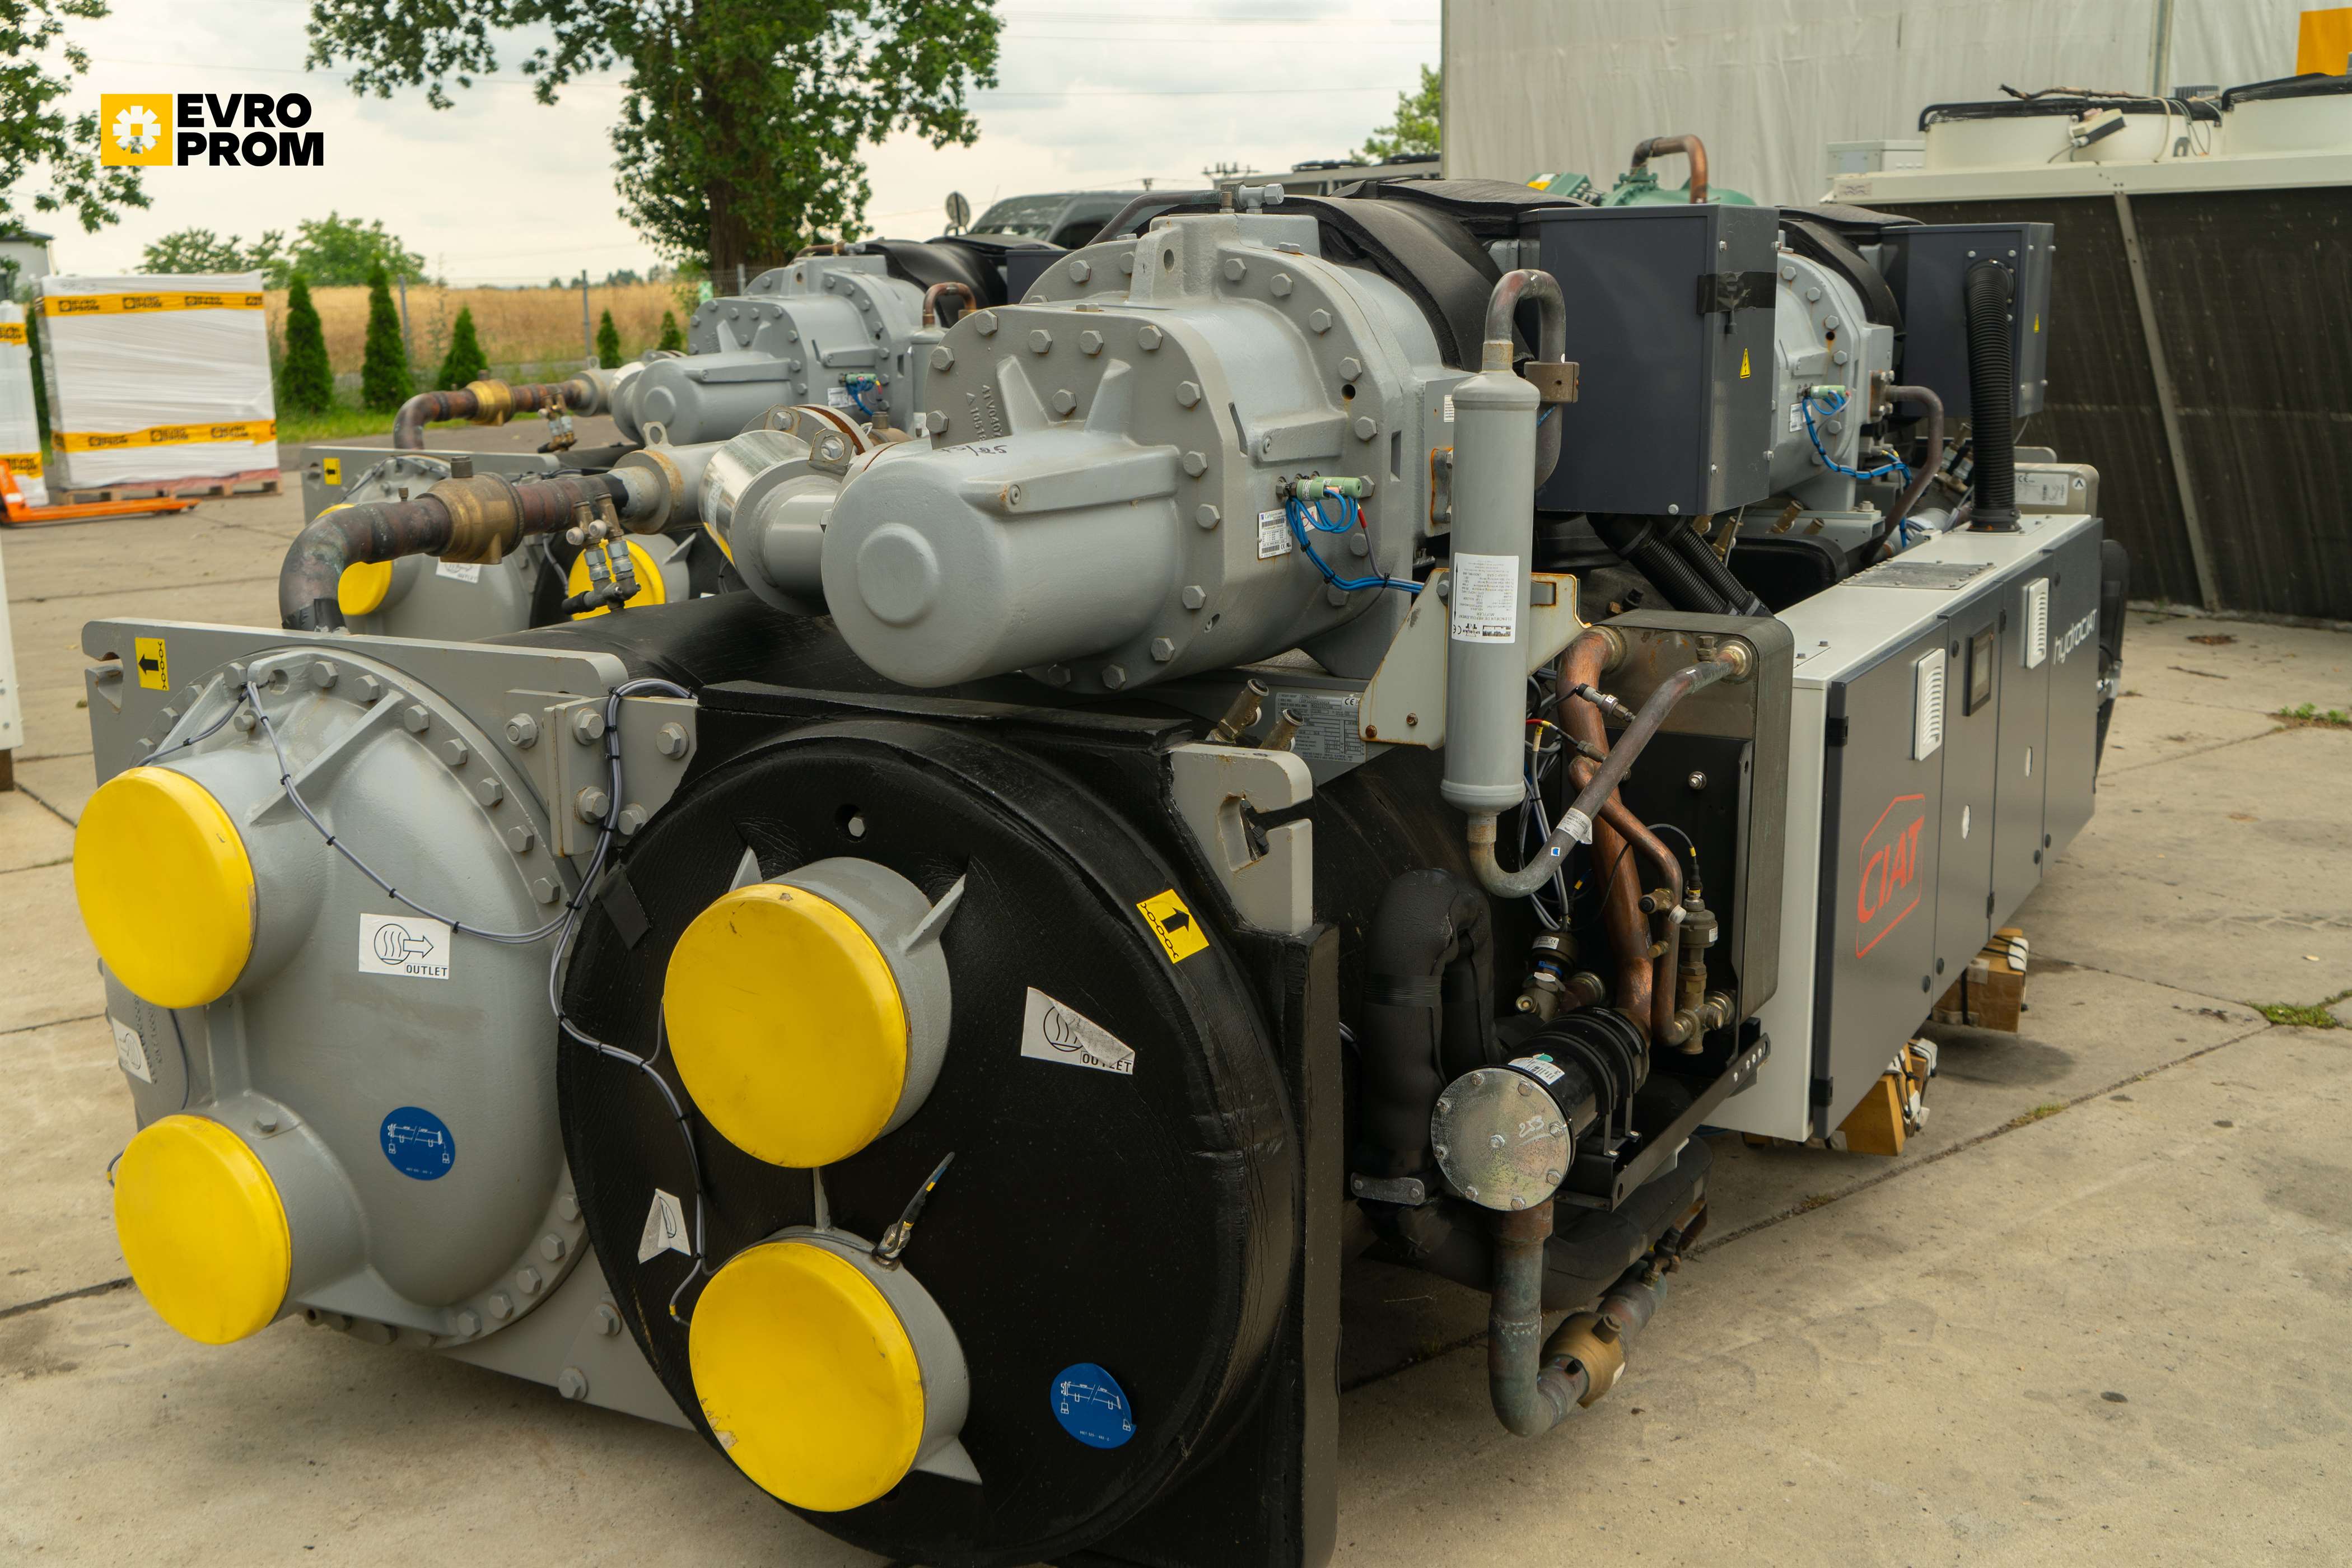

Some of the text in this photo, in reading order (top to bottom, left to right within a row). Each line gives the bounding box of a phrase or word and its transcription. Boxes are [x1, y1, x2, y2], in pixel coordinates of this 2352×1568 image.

[1858, 815, 1925, 923] CIAT
[407, 964, 447, 976] OUTLET
[1082, 1053, 1131, 1072] OUET
